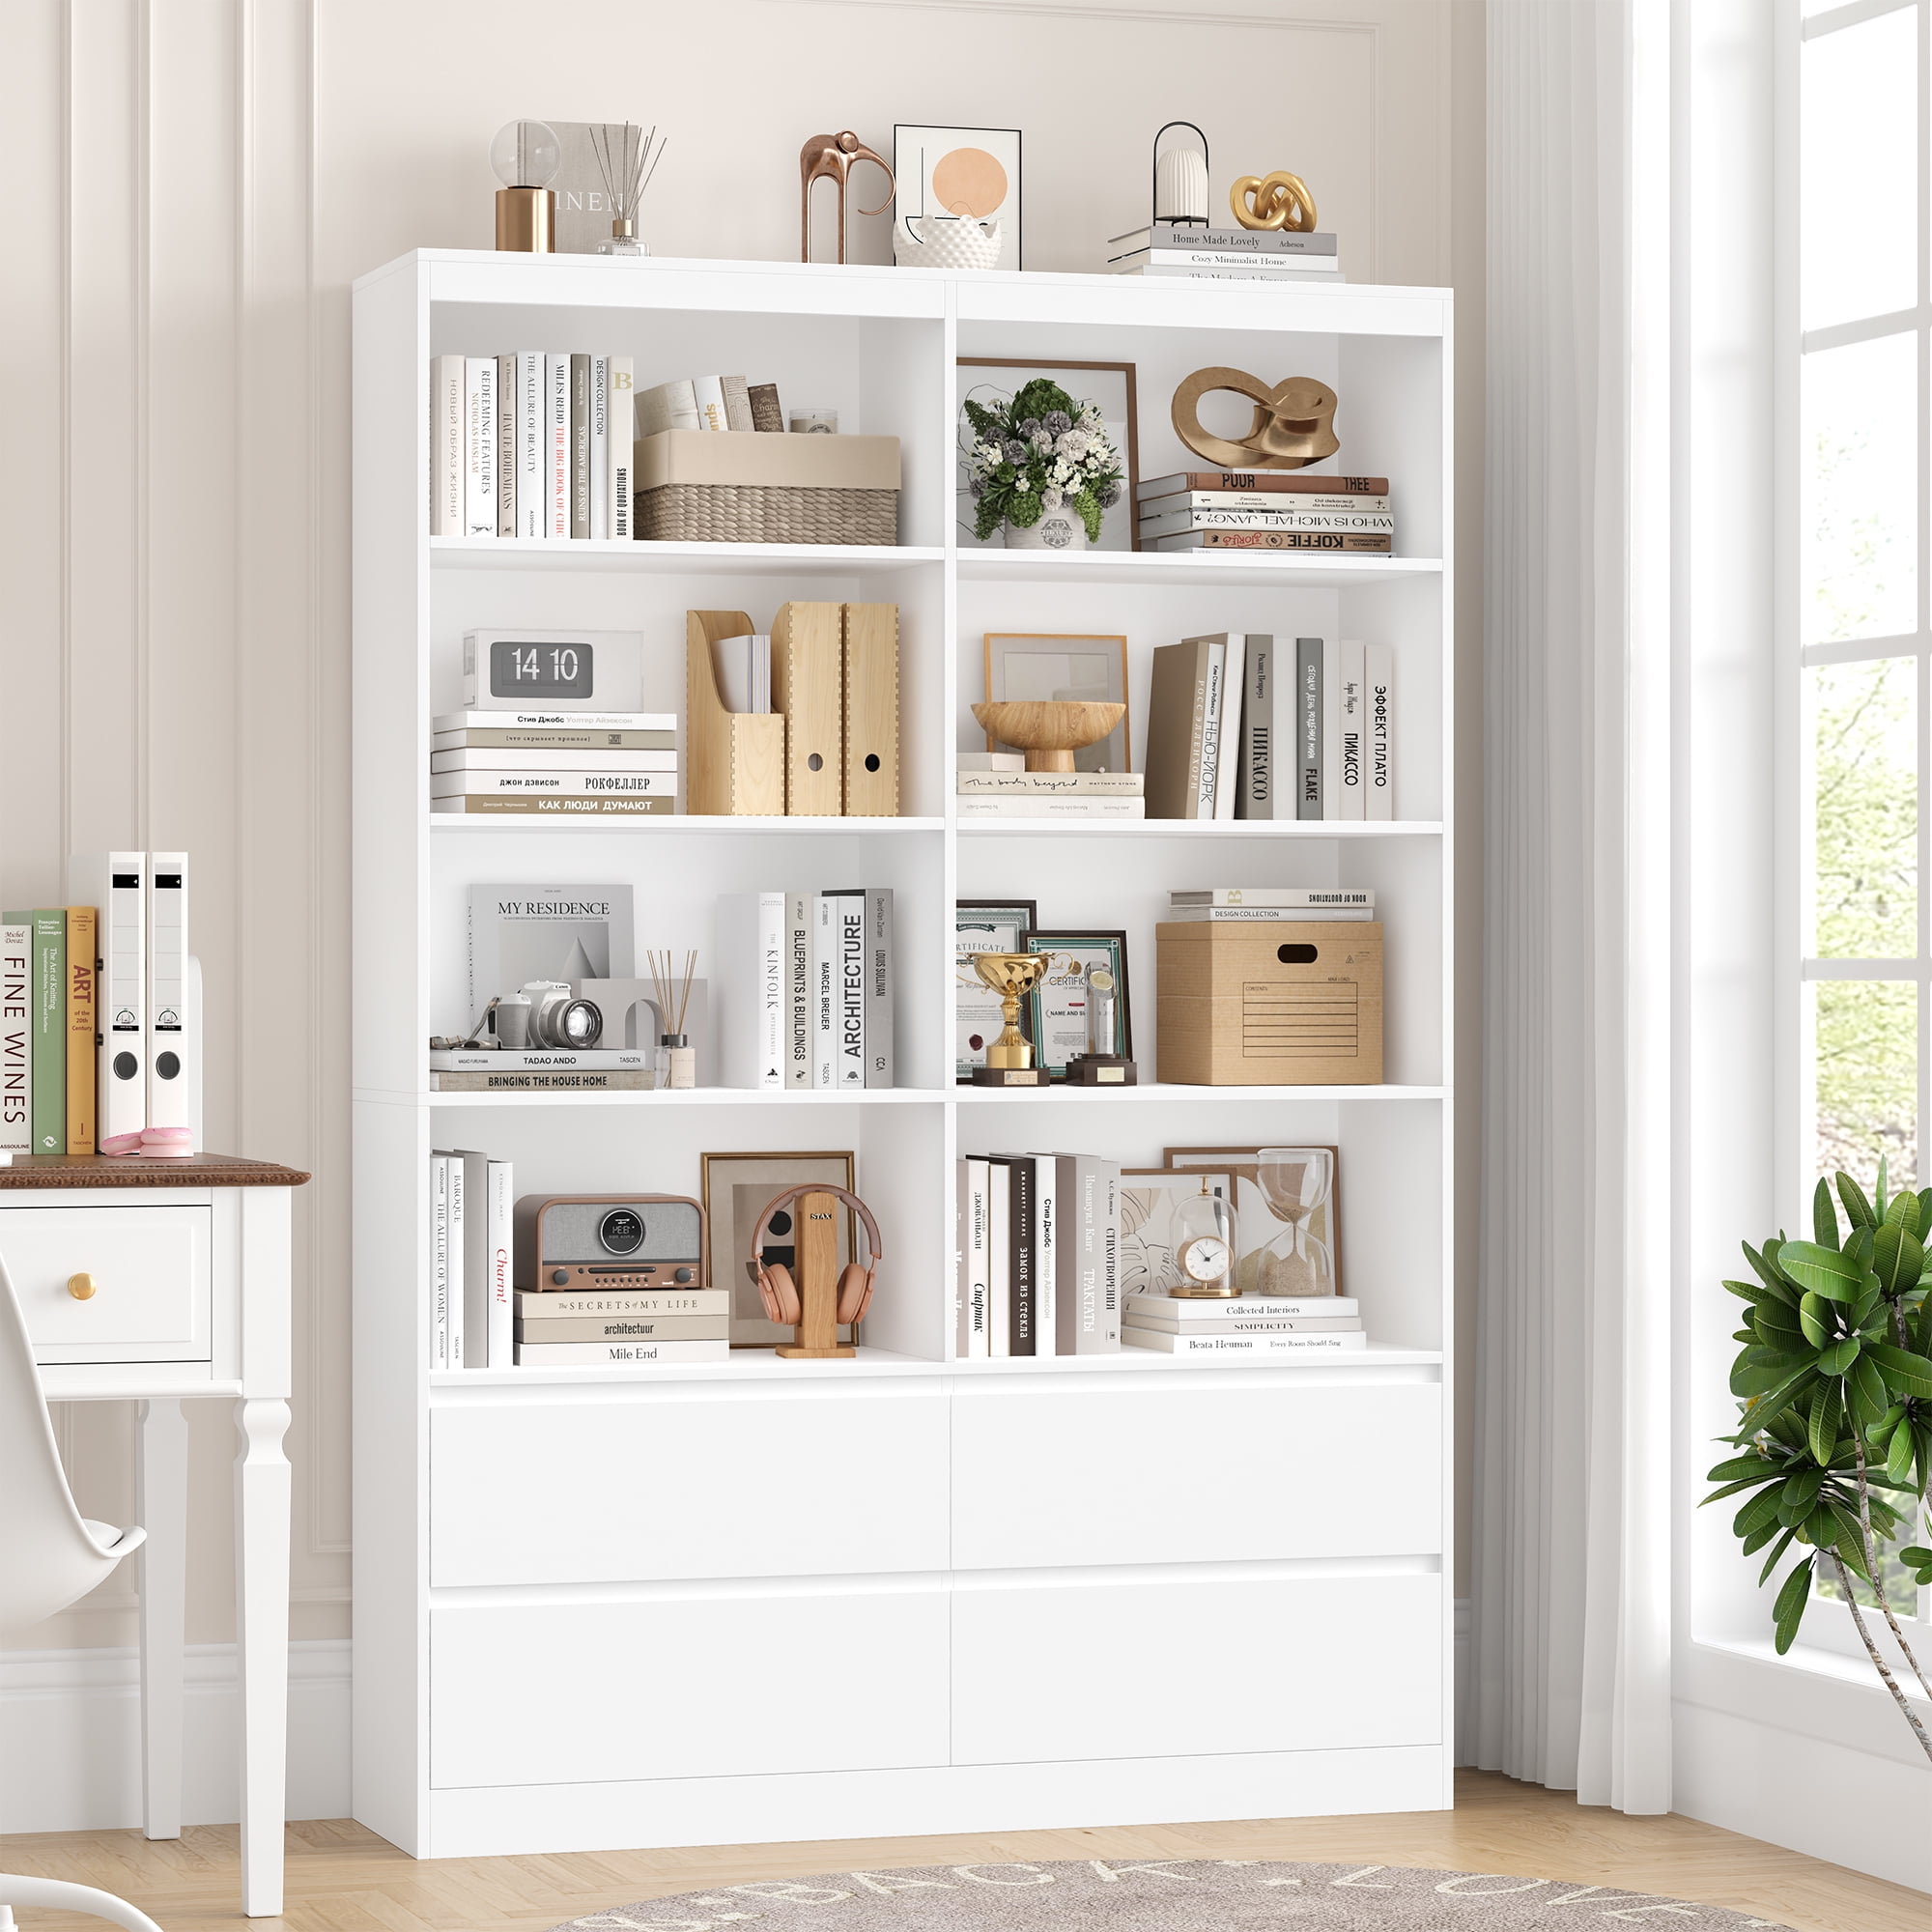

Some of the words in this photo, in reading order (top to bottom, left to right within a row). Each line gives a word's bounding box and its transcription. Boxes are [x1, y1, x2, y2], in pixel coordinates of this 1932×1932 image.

[554, 190, 626, 213] INEN
[1173, 234, 1200, 244] Home
[1203, 235, 1228, 245] Made
[1230, 236, 1261, 249] Lovely
[1191, 254, 1212, 265] Cozy
[1214, 255, 1259, 265] Minimalist
[1260, 257, 1287, 266] Home
[555, 364, 564, 394] MILES
[612, 372, 632, 389] B
[481, 370, 491, 436] REDEEMING
[555, 396, 564, 424] REDD
[502, 412, 512, 449] HAUTE
[527, 417, 535, 432] OF
[555, 425, 564, 446] THE
[481, 440, 491, 495] FEATURES
[555, 449, 564, 466] BIG
[502, 450, 512, 509] BOHEMIANS
[555, 468, 564, 495] BOOK
[579, 484, 585, 496] OF
[616, 468, 627, 508] QUOTATIONS
[1222, 473, 1256, 488] PUUR
[1343, 477, 1371, 492] THEE
[555, 497, 564, 511] OF
[616, 508, 627, 518] OF
[555, 513, 564, 537] CHIC
[616, 519, 627, 536] BOOK
[1207, 514, 1259, 525] JANG?
[1260, 515, 1331, 526] MICHAEL
[1334, 517, 1349, 526] IS
[1351, 517, 1394, 527] WHO
[1288, 534, 1344, 548] KOFFIE
[512, 648, 540, 681] 14
[549, 648, 579, 681] 10
[1306, 693, 1316, 710] ДЕНЬ
[1375, 686, 1386, 739] ЭФФЕКТ
[1201, 721, 1218, 804] НЬЮ-ЙОРК
[1252, 726, 1268, 801] ПИКАССО
[1344, 733, 1358, 786] ПИКАССО
[1375, 743, 1386, 787] ПЛАТО
[585, 777, 651, 790] РОКФЕЛЛЕР
[1305, 768, 1318, 802] FLAKE
[539, 801, 561, 810] КАК
[563, 801, 598, 811] ЛЮДИ
[602, 801, 652, 811] ДУМАЮТ
[1228, 890, 1242, 904] B
[1308, 894, 1342, 902] QUOTATIONS
[497, 901, 522, 915] MY
[526, 901, 611, 915] RESIDENCE
[49, 948, 58, 961] The
[956, 943, 1006, 952] RTIFICATE
[794, 930, 806, 993] BLUEPRINTS
[875, 950, 886, 967] LOUIS
[4, 957, 25, 1018] FINE
[73, 964, 92, 1004] ART
[767, 950, 779, 1009] KINFOLK
[821, 961, 830, 996] MARCEL
[844, 915, 862, 1059] ARCHITECTURE
[875, 969, 886, 997] SULLIVAN
[48, 982, 57, 1010] Knitting
[794, 995, 806, 1004] &
[821, 997, 830, 1031] BREUER
[794, 1006, 806, 1061] BUILDINGS
[875, 1057, 886, 1071] CCA
[4, 1032, 25, 1123] WINES
[488, 1076, 531, 1087] BRINGING
[532, 1076, 550, 1086] THE
[552, 1076, 581, 1086] HOUSE
[582, 1076, 608, 1086] HOME
[1043, 1199, 1052, 1218] Стив
[1043, 1220, 1052, 1248] Джобс
[1085, 1228, 1095, 1253] Кант
[438, 1266, 445, 1281] OF
[496, 1248, 508, 1303] Charm!
[1105, 1228, 1116, 1310] СТИХОТВОРЕНИЯ
[1019, 1285, 1028, 1297] из
[1083, 1268, 1095, 1332] ТРАКТАТЫ
[569, 1300, 631, 1310] SECRETS
[639, 1300, 659, 1309] MY
[668, 1299, 698, 1308] LIFE
[971, 1283, 985, 1333] Спартак
[1226, 1306, 1265, 1316] Collected
[1266, 1305, 1300, 1315] Interiors
[604, 1322, 655, 1335] architectuur
[609, 1349, 634, 1360] Mile
[636, 1348, 658, 1359] End
[1189, 1340, 1213, 1350] Beata
[1215, 1339, 1253, 1349] Heuman
[1269, 1340, 1287, 1350] Every
[723, 1860, 1196, 1905] BACK
[1331, 1864, 1700, 1922] LOVE
